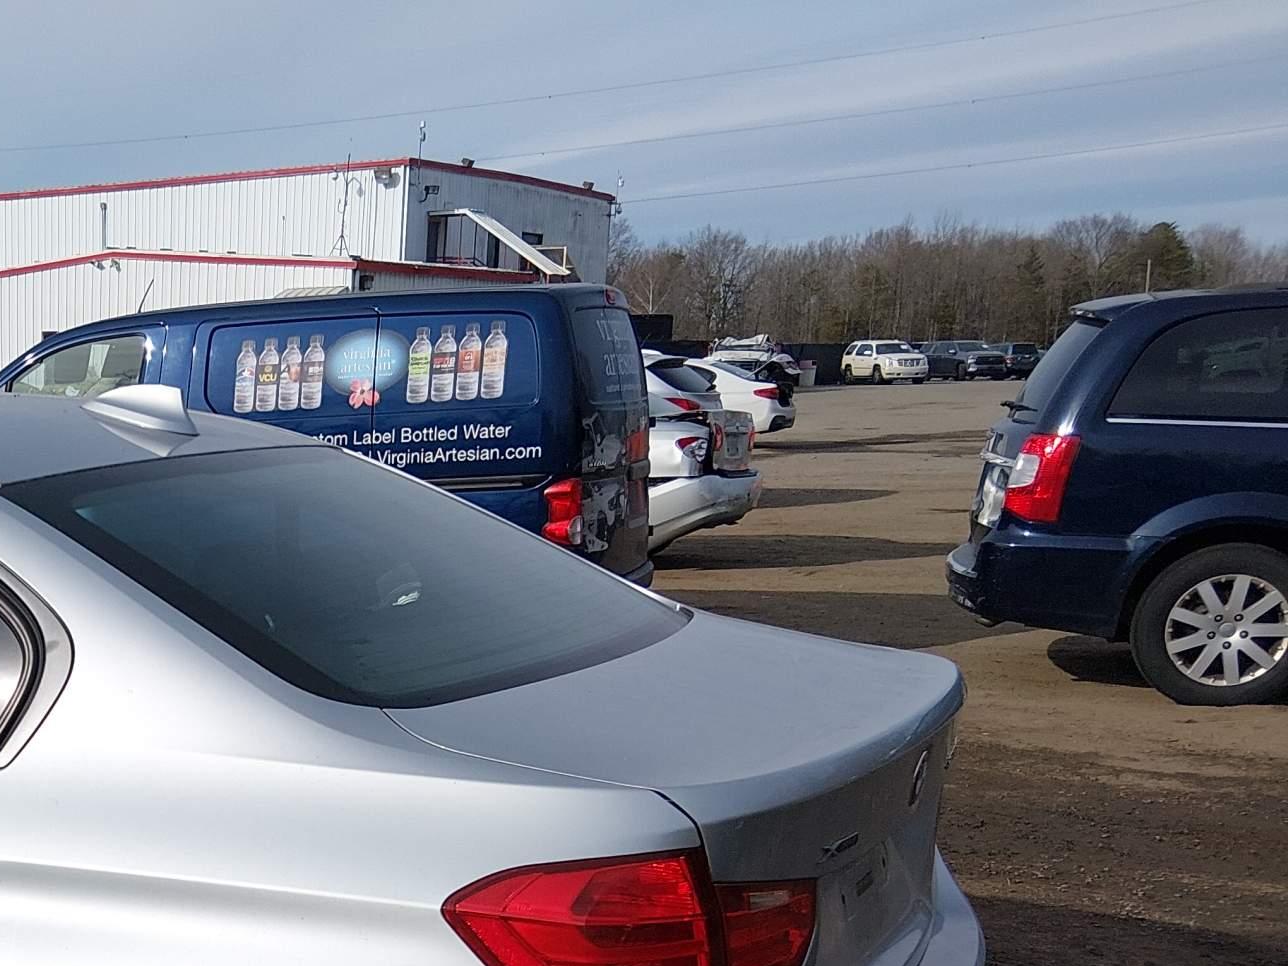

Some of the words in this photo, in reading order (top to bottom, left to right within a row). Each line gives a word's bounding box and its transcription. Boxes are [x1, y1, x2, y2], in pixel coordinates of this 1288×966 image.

[258, 373, 278, 383] VCU
[353, 428, 395, 446] Label
[401, 426, 458, 443] Bottled
[463, 424, 512, 440] Water
[377, 445, 542, 468] VirginiaArtesian.com
